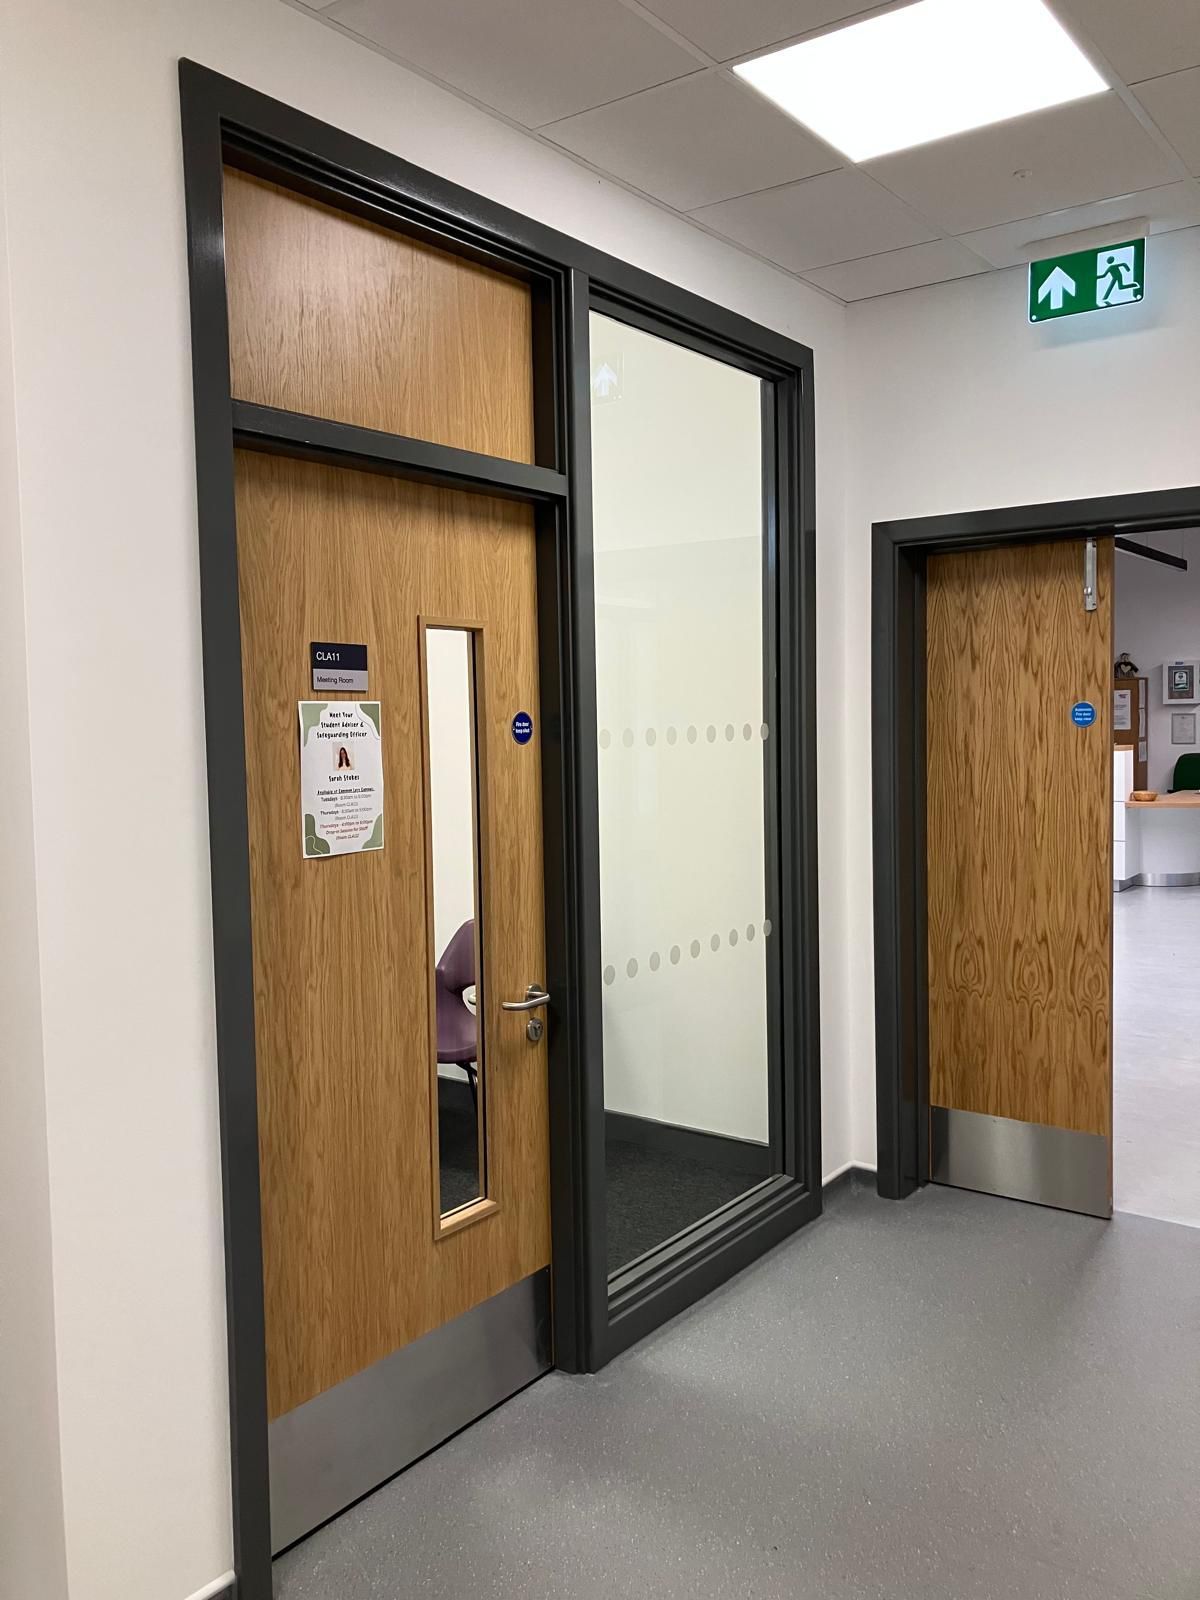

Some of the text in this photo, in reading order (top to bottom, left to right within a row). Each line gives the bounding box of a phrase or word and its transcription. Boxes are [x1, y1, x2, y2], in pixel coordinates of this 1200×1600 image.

[316, 651, 340, 661] CLA11
[316, 676, 354, 684] Meeting Room
[316, 730, 367, 739] Safeguarding Officer
